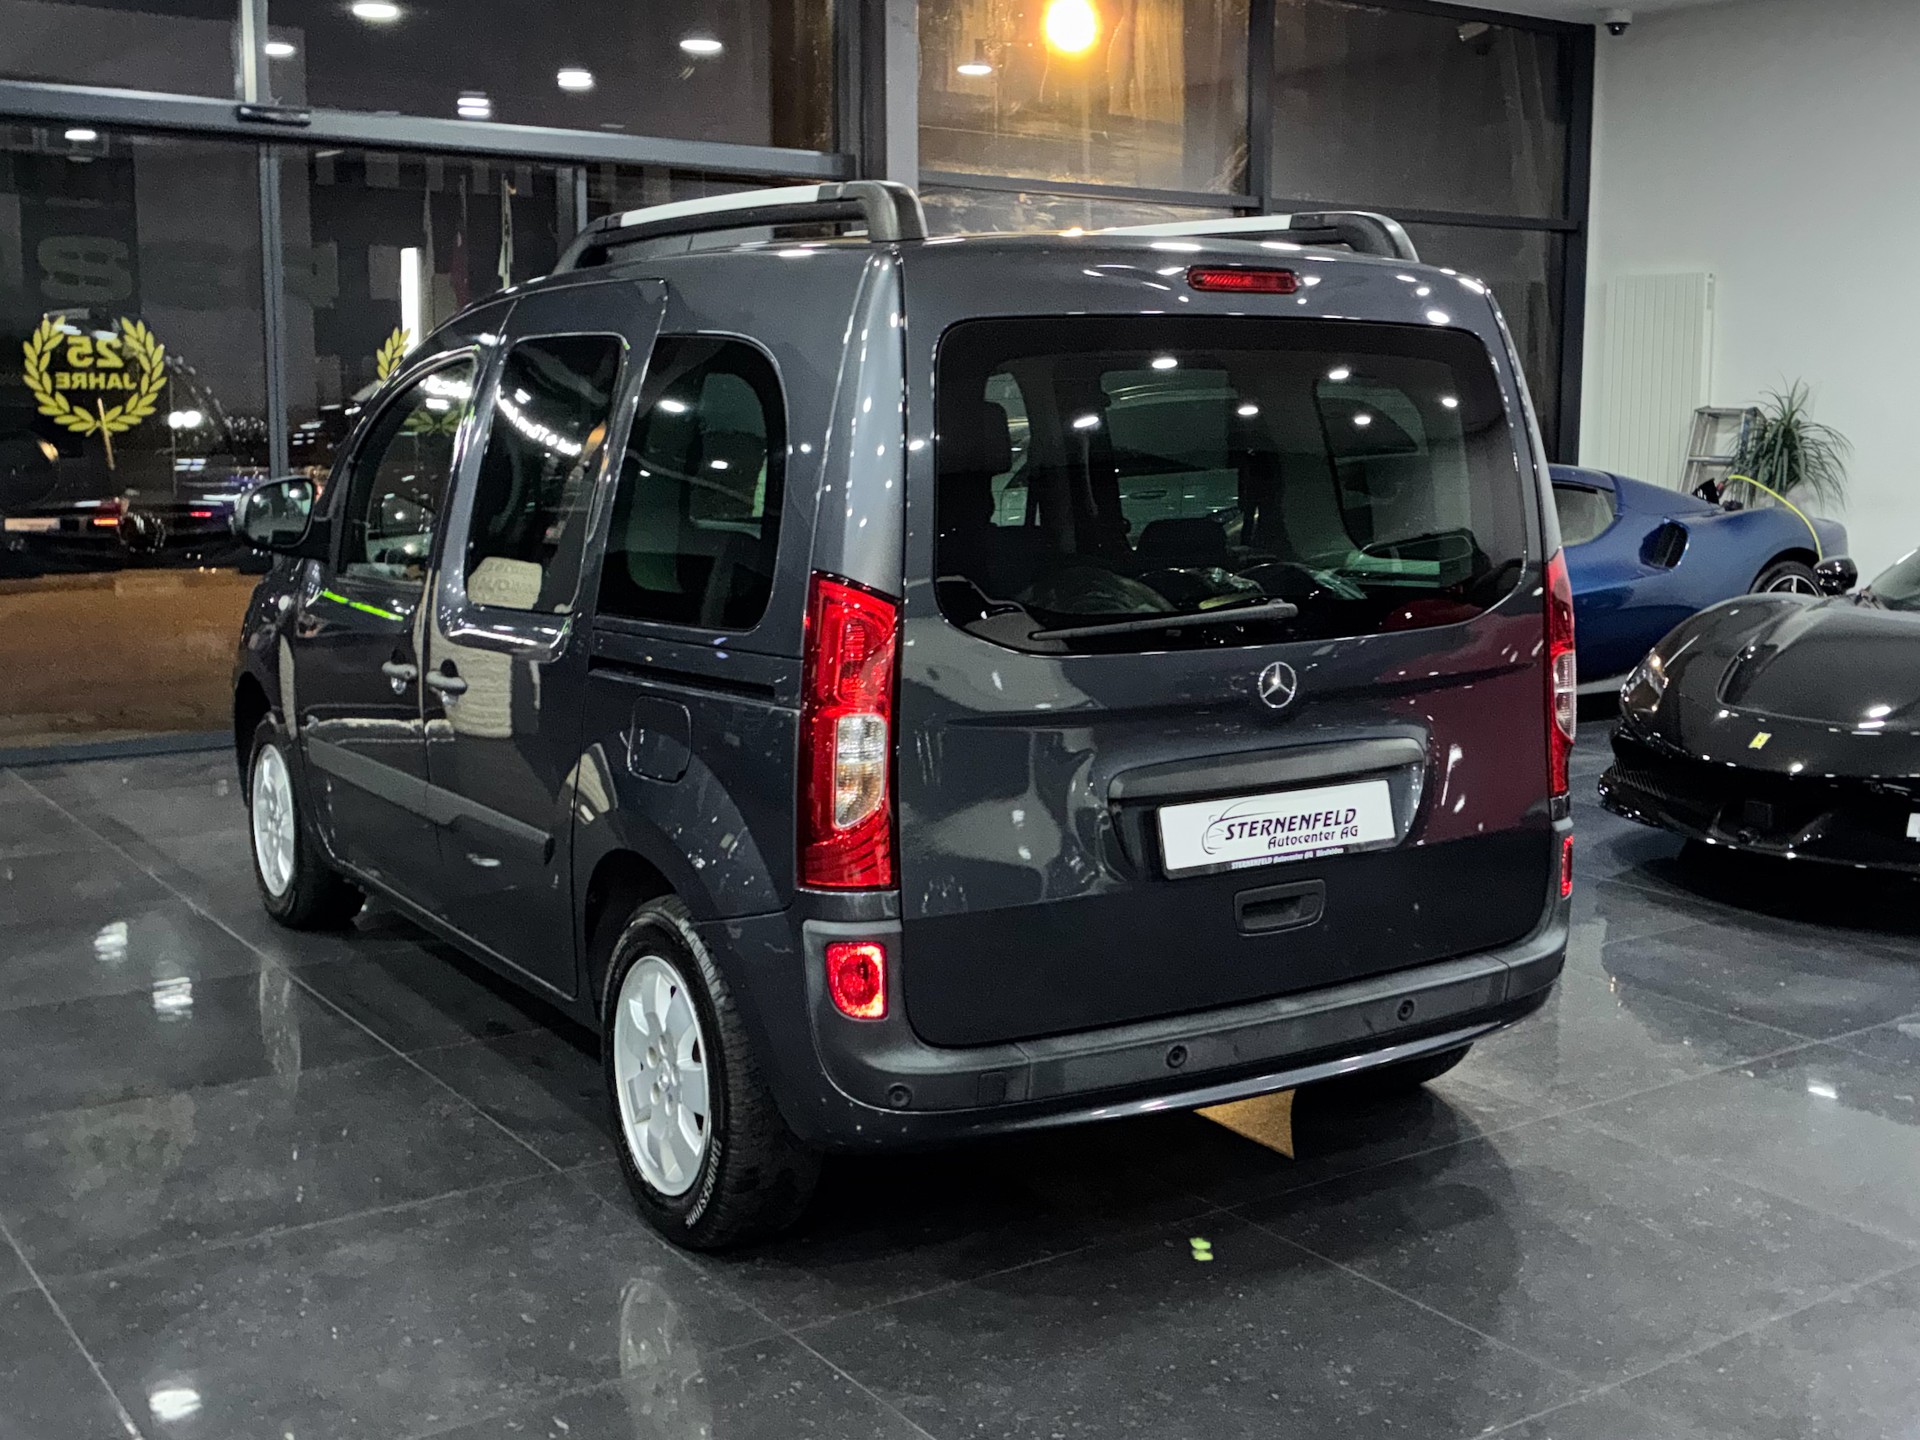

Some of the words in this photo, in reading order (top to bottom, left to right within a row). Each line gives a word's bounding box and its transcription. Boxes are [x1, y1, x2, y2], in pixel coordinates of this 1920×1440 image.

[1225, 808, 1357, 840] STERNENFELD
[1267, 829, 1335, 850] Autocenter
[1340, 825, 1359, 839] AG
